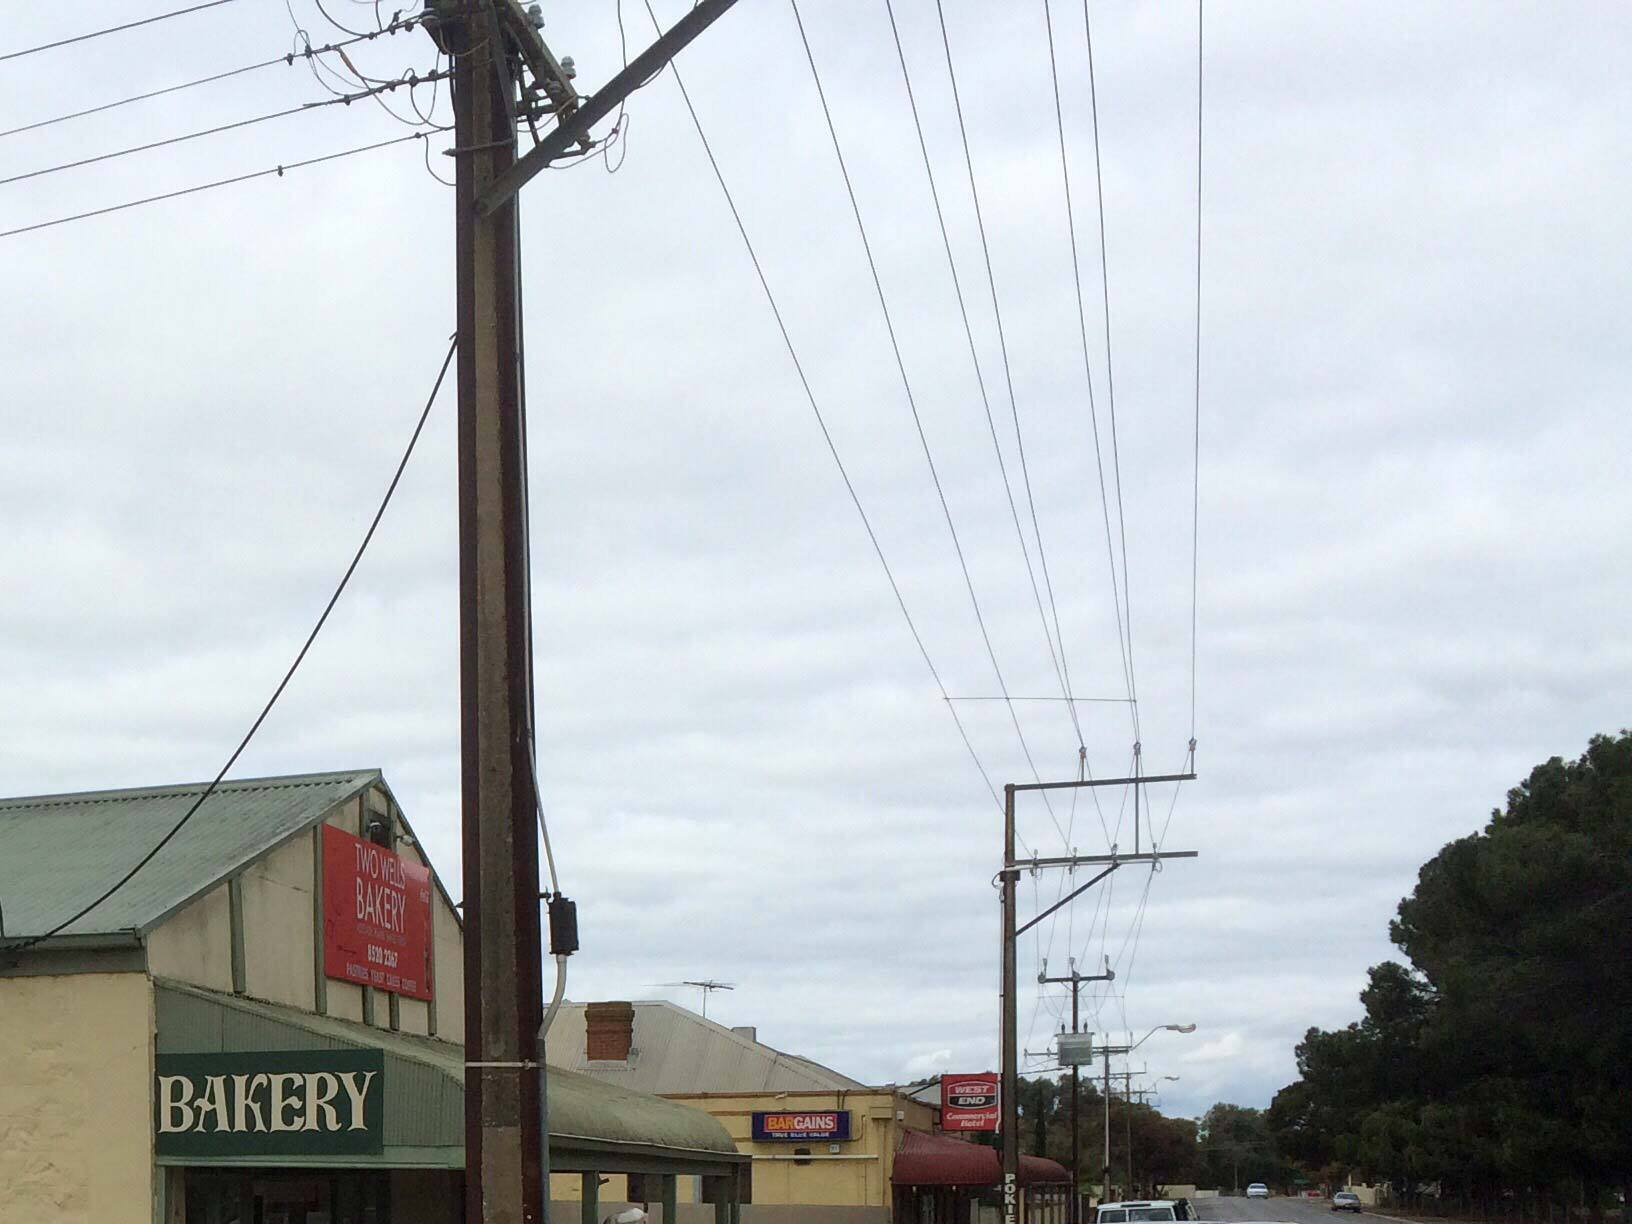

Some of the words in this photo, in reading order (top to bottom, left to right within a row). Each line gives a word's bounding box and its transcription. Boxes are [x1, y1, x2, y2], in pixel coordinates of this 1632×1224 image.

[355, 843, 379, 879] TWO
[380, 856, 406, 890] WELLS
[356, 876, 407, 933] BAKERY
[954, 1085, 989, 1094] WEST
[157, 1071, 378, 1134] BAKERY
[958, 1096, 986, 1105] END
[768, 1116, 834, 1130] BARGAINS
[960, 1119, 985, 1127] Hotel
